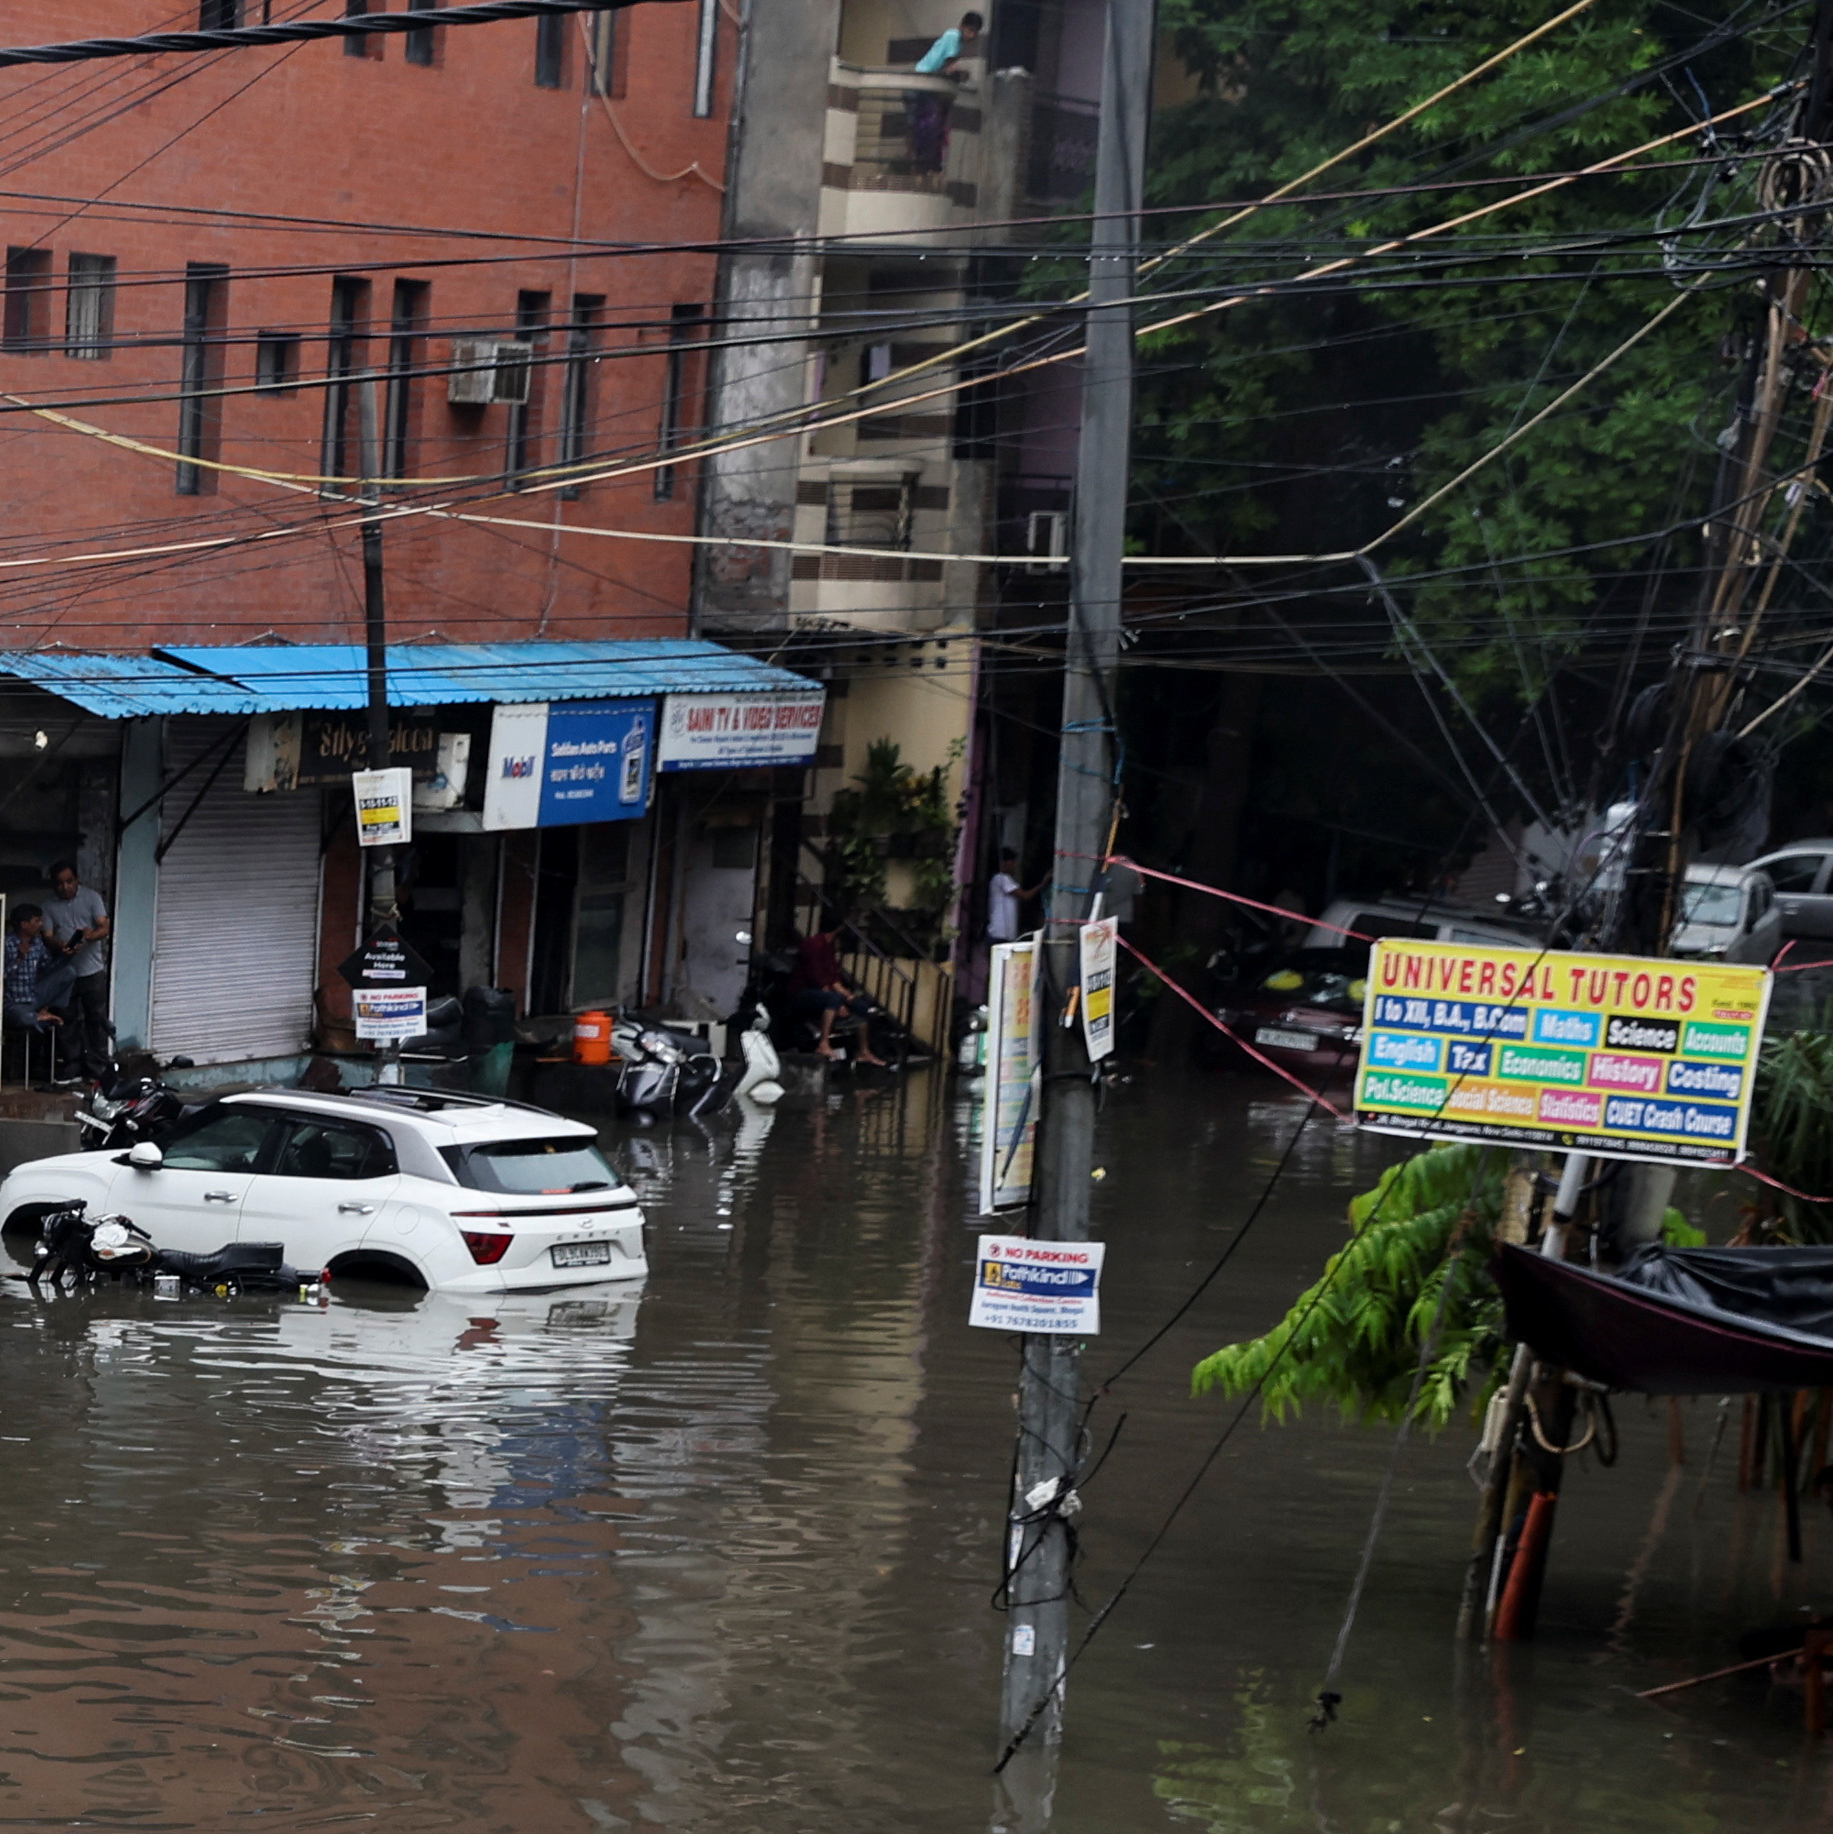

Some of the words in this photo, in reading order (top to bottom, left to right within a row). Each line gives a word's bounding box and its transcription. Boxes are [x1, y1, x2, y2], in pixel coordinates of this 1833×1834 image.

[364, 953, 405, 961] Available
[1383, 953, 1555, 1000] UNIVERSAL
[1570, 968, 1696, 1013] TUTORS
[1385, 999, 1403, 1021] to
[1541, 1015, 1593, 1041] Maths
[1607, 1019, 1677, 1049] Science
[1685, 1026, 1747, 1055] Accounts
[1373, 1035, 1436, 1066] English
[1501, 1050, 1582, 1080] Economics
[1593, 1056, 1659, 1090] History
[1668, 1063, 1741, 1098] Costing
[1487, 1089, 1533, 1115] Science
[1540, 1093, 1600, 1123] Statistics
[1606, 1099, 1644, 1126] CUET
[1644, 1103, 1683, 1131] Crash
[1684, 1107, 1732, 1135] Course
[1005, 1248, 1023, 1258] NO
[1025, 1250, 1089, 1263] PARKING
[1002, 1264, 1066, 1284] Pathkind
